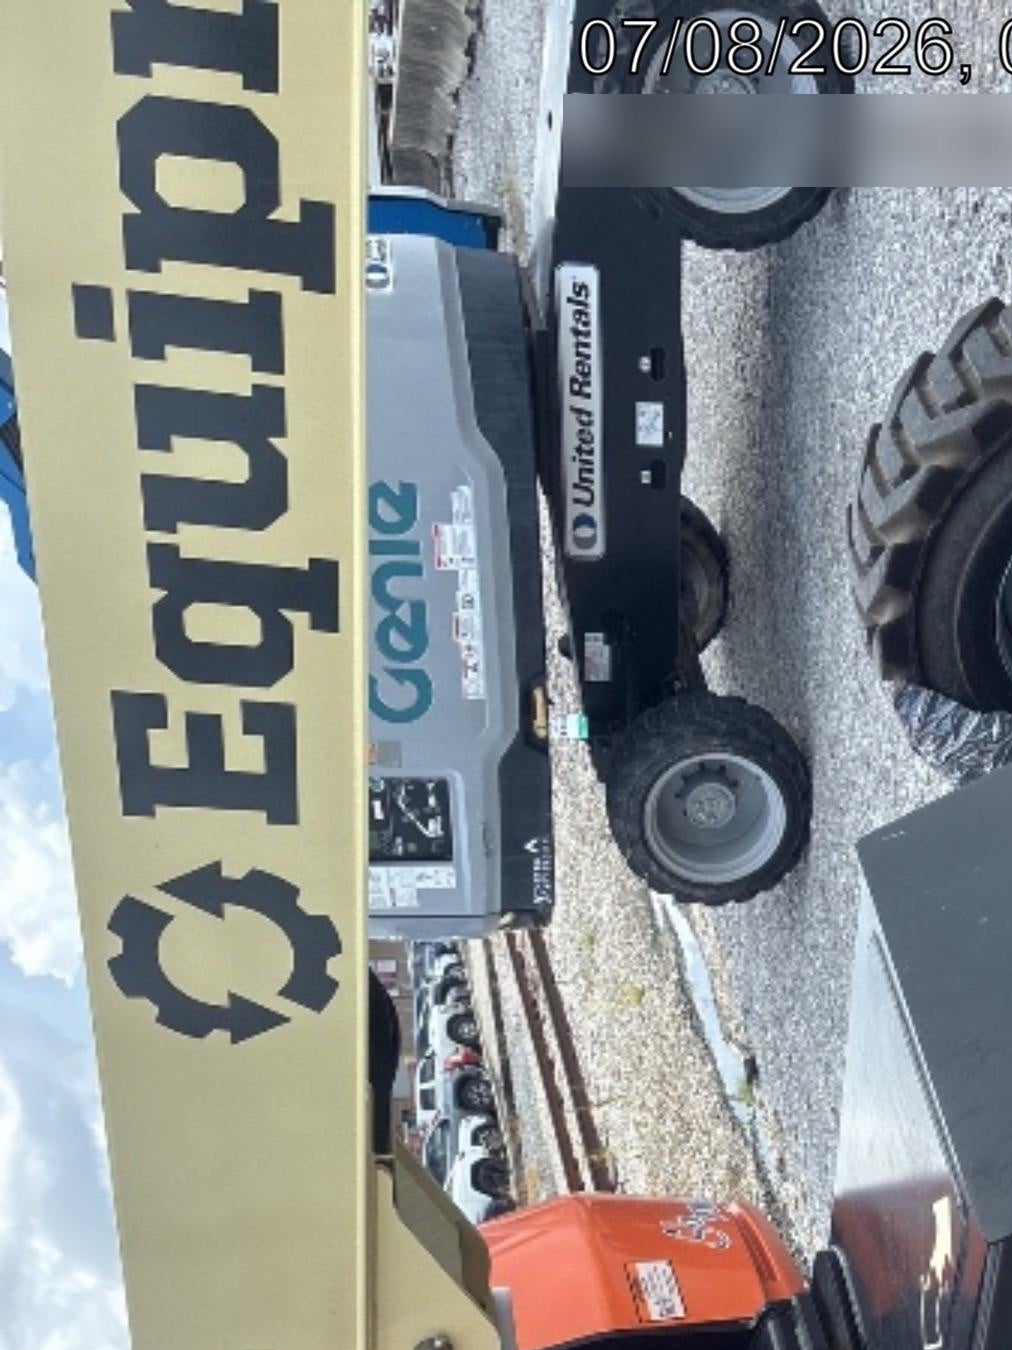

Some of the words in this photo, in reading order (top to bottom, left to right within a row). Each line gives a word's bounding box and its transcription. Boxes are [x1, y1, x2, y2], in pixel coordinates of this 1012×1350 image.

[566, 280, 593, 400] Rentals
[570, 404, 595, 508] United
[368, 480, 433, 723] Genie
